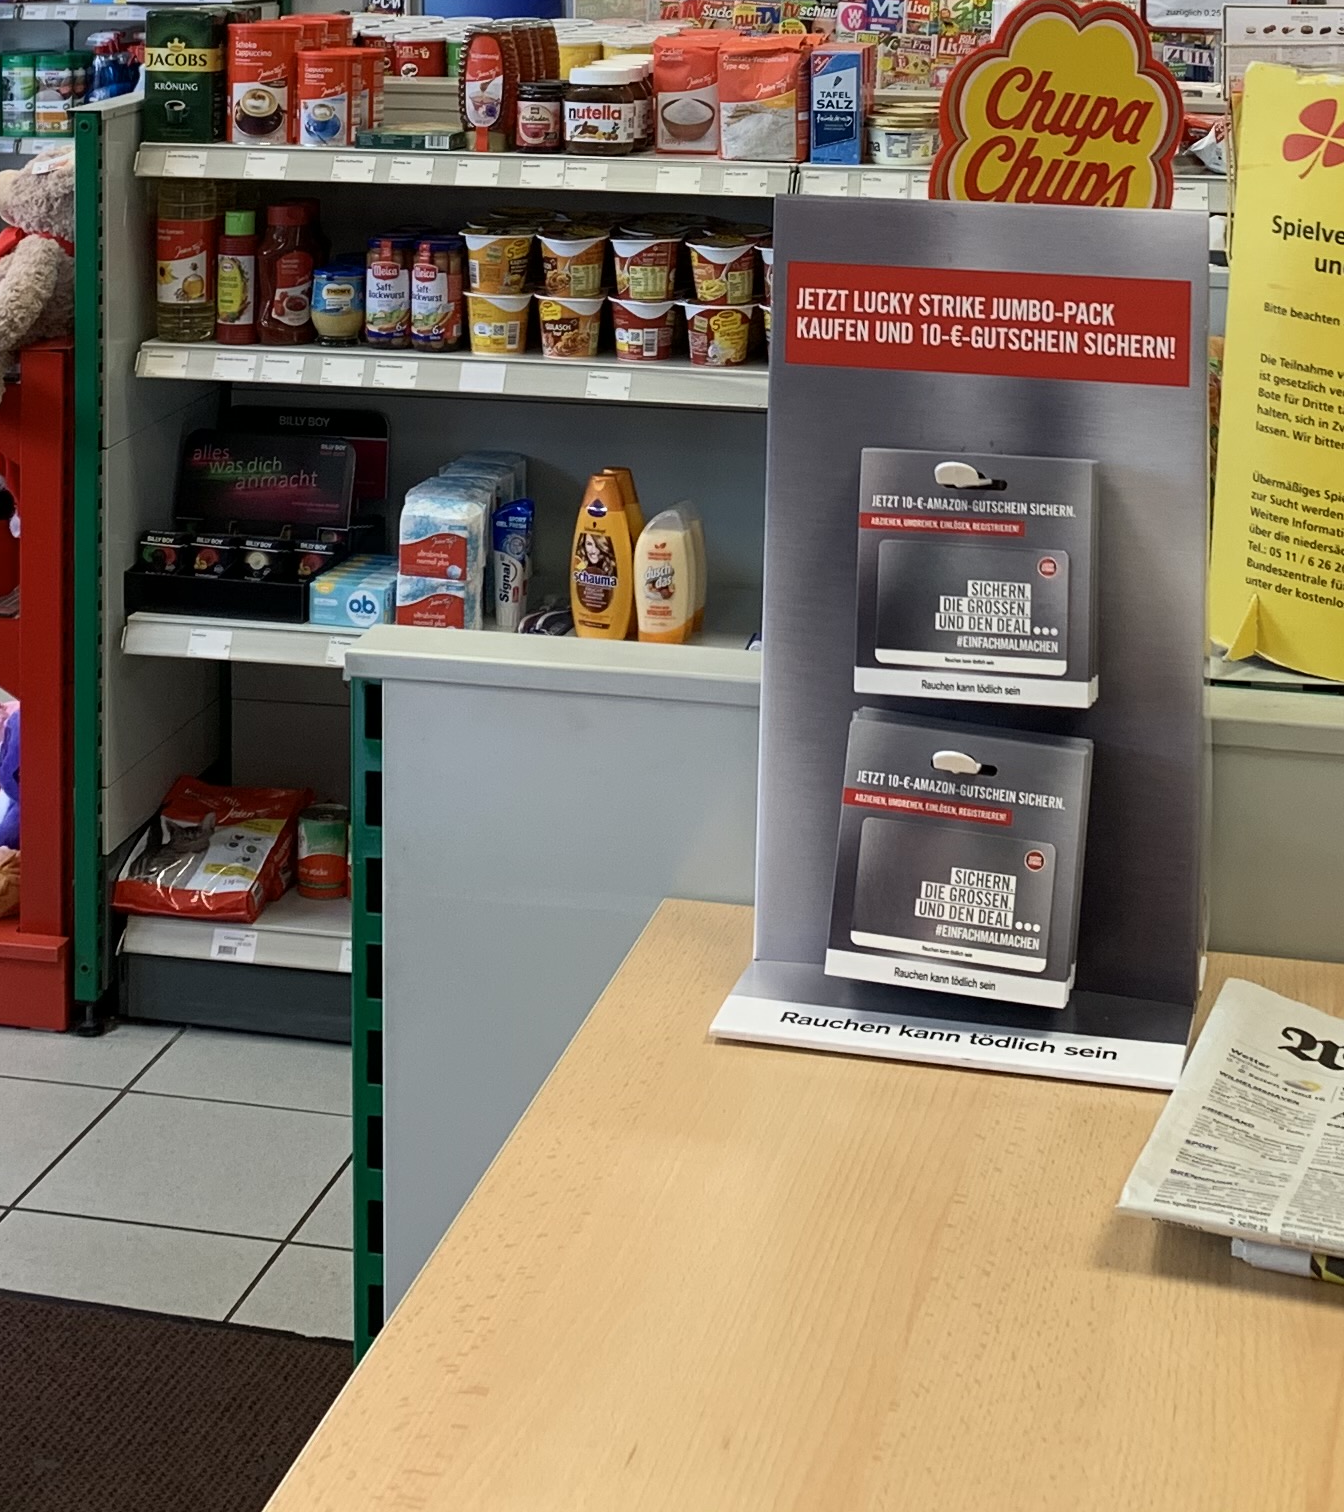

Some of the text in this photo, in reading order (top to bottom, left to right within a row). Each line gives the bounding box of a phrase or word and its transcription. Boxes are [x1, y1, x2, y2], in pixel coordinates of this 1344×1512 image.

[907, 0, 930, 15] Lisa
[146, 52, 208, 67] JACOBS
[235, 49, 272, 58] Cappuccino
[154, 81, 198, 91] KRÖNUNG
[820, 91, 850, 99] TAFEL
[568, 105, 622, 121] nutella
[816, 99, 853, 110] SALZ
[986, 66, 1153, 156] Chupa
[964, 133, 1136, 206] Chups
[373, 262, 399, 278] Meica
[376, 282, 394, 292] Saft-
[796, 288, 1115, 326] JETZT LUCKY STRIKE JUMBO-PACK
[1263, 302, 1288, 316] Bitte
[1289, 306, 1340, 327] beachten
[796, 316, 1176, 359] KAUFEN UND 10-€-GUTSCHEIN SICHERN!
[1260, 353, 1277, 366] Die
[1279, 357, 1334, 378] Teilnahme
[279, 415, 330, 427] BILLY BOY
[193, 444, 230, 461] alles
[209, 456, 282, 474] was dich
[235, 470, 318, 490] anmacht
[872, 495, 1076, 517] JETZT 10-€-AMAZON-GUTSCHEIN SICHERN.
[871, 517, 903, 527] ABZIEHEN,
[972, 522, 1020, 533] REGISTRIEREN!
[573, 571, 617, 587] schauma
[644, 563, 672, 580] dusch
[499, 562, 512, 603] Signal
[655, 574, 673, 589] das
[971, 582, 1029, 599] SICHERN.
[349, 596, 377, 615] o.b.
[943, 598, 1029, 616] DIE GROSSEN.
[939, 614, 964, 629] UND
[968, 616, 993, 631] DEN
[957, 636, 1058, 653] #EINFACHMALMACHEN
[921, 679, 1020, 695] Rauchen kann tödlich sein
[779, 1011, 1119, 1063] Rauchen kann tödlich sein
[1218, 1070, 1300, 1106] WILHELMSHAVEN
